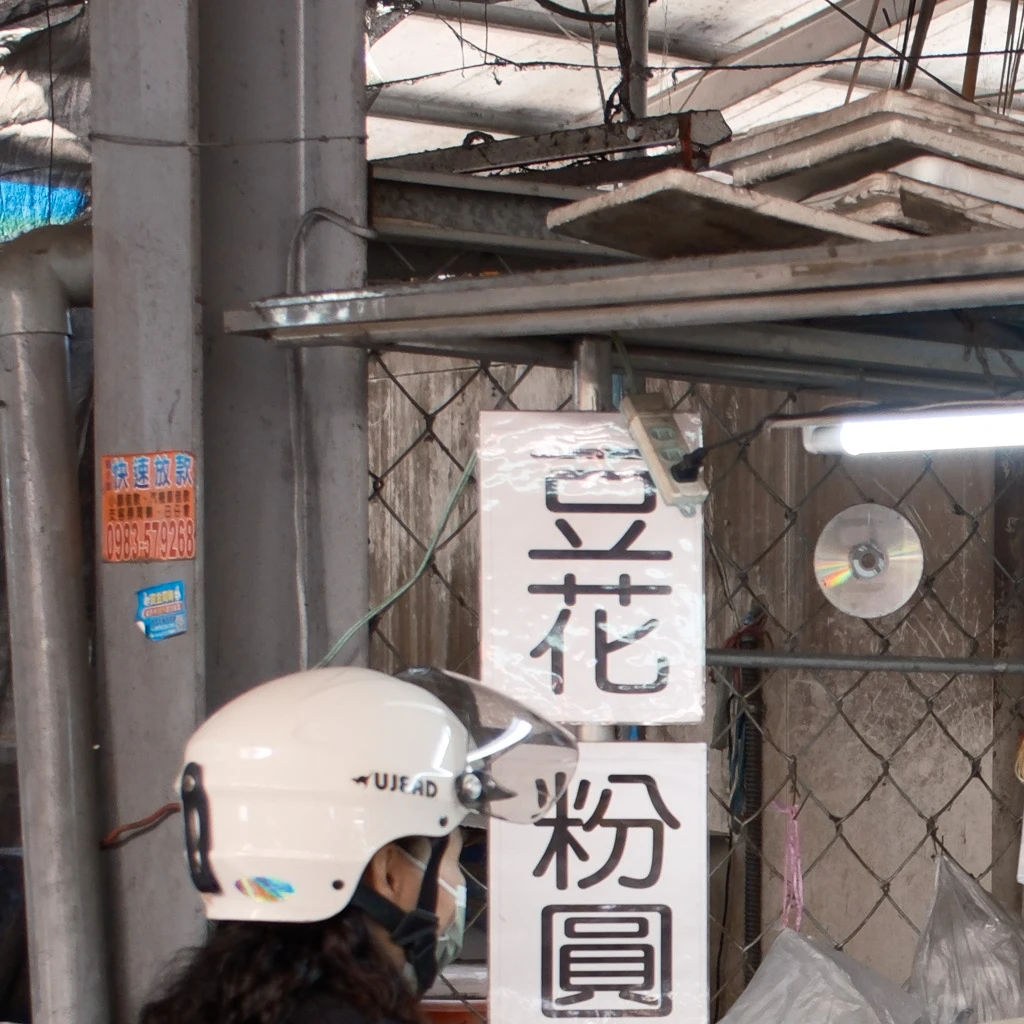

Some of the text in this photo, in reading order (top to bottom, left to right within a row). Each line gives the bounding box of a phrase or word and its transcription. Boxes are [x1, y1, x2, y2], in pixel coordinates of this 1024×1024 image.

[112, 454, 194, 491] 快速放款
[106, 519, 194, 562] 0983-579268
[527, 448, 673, 694] 豆花
